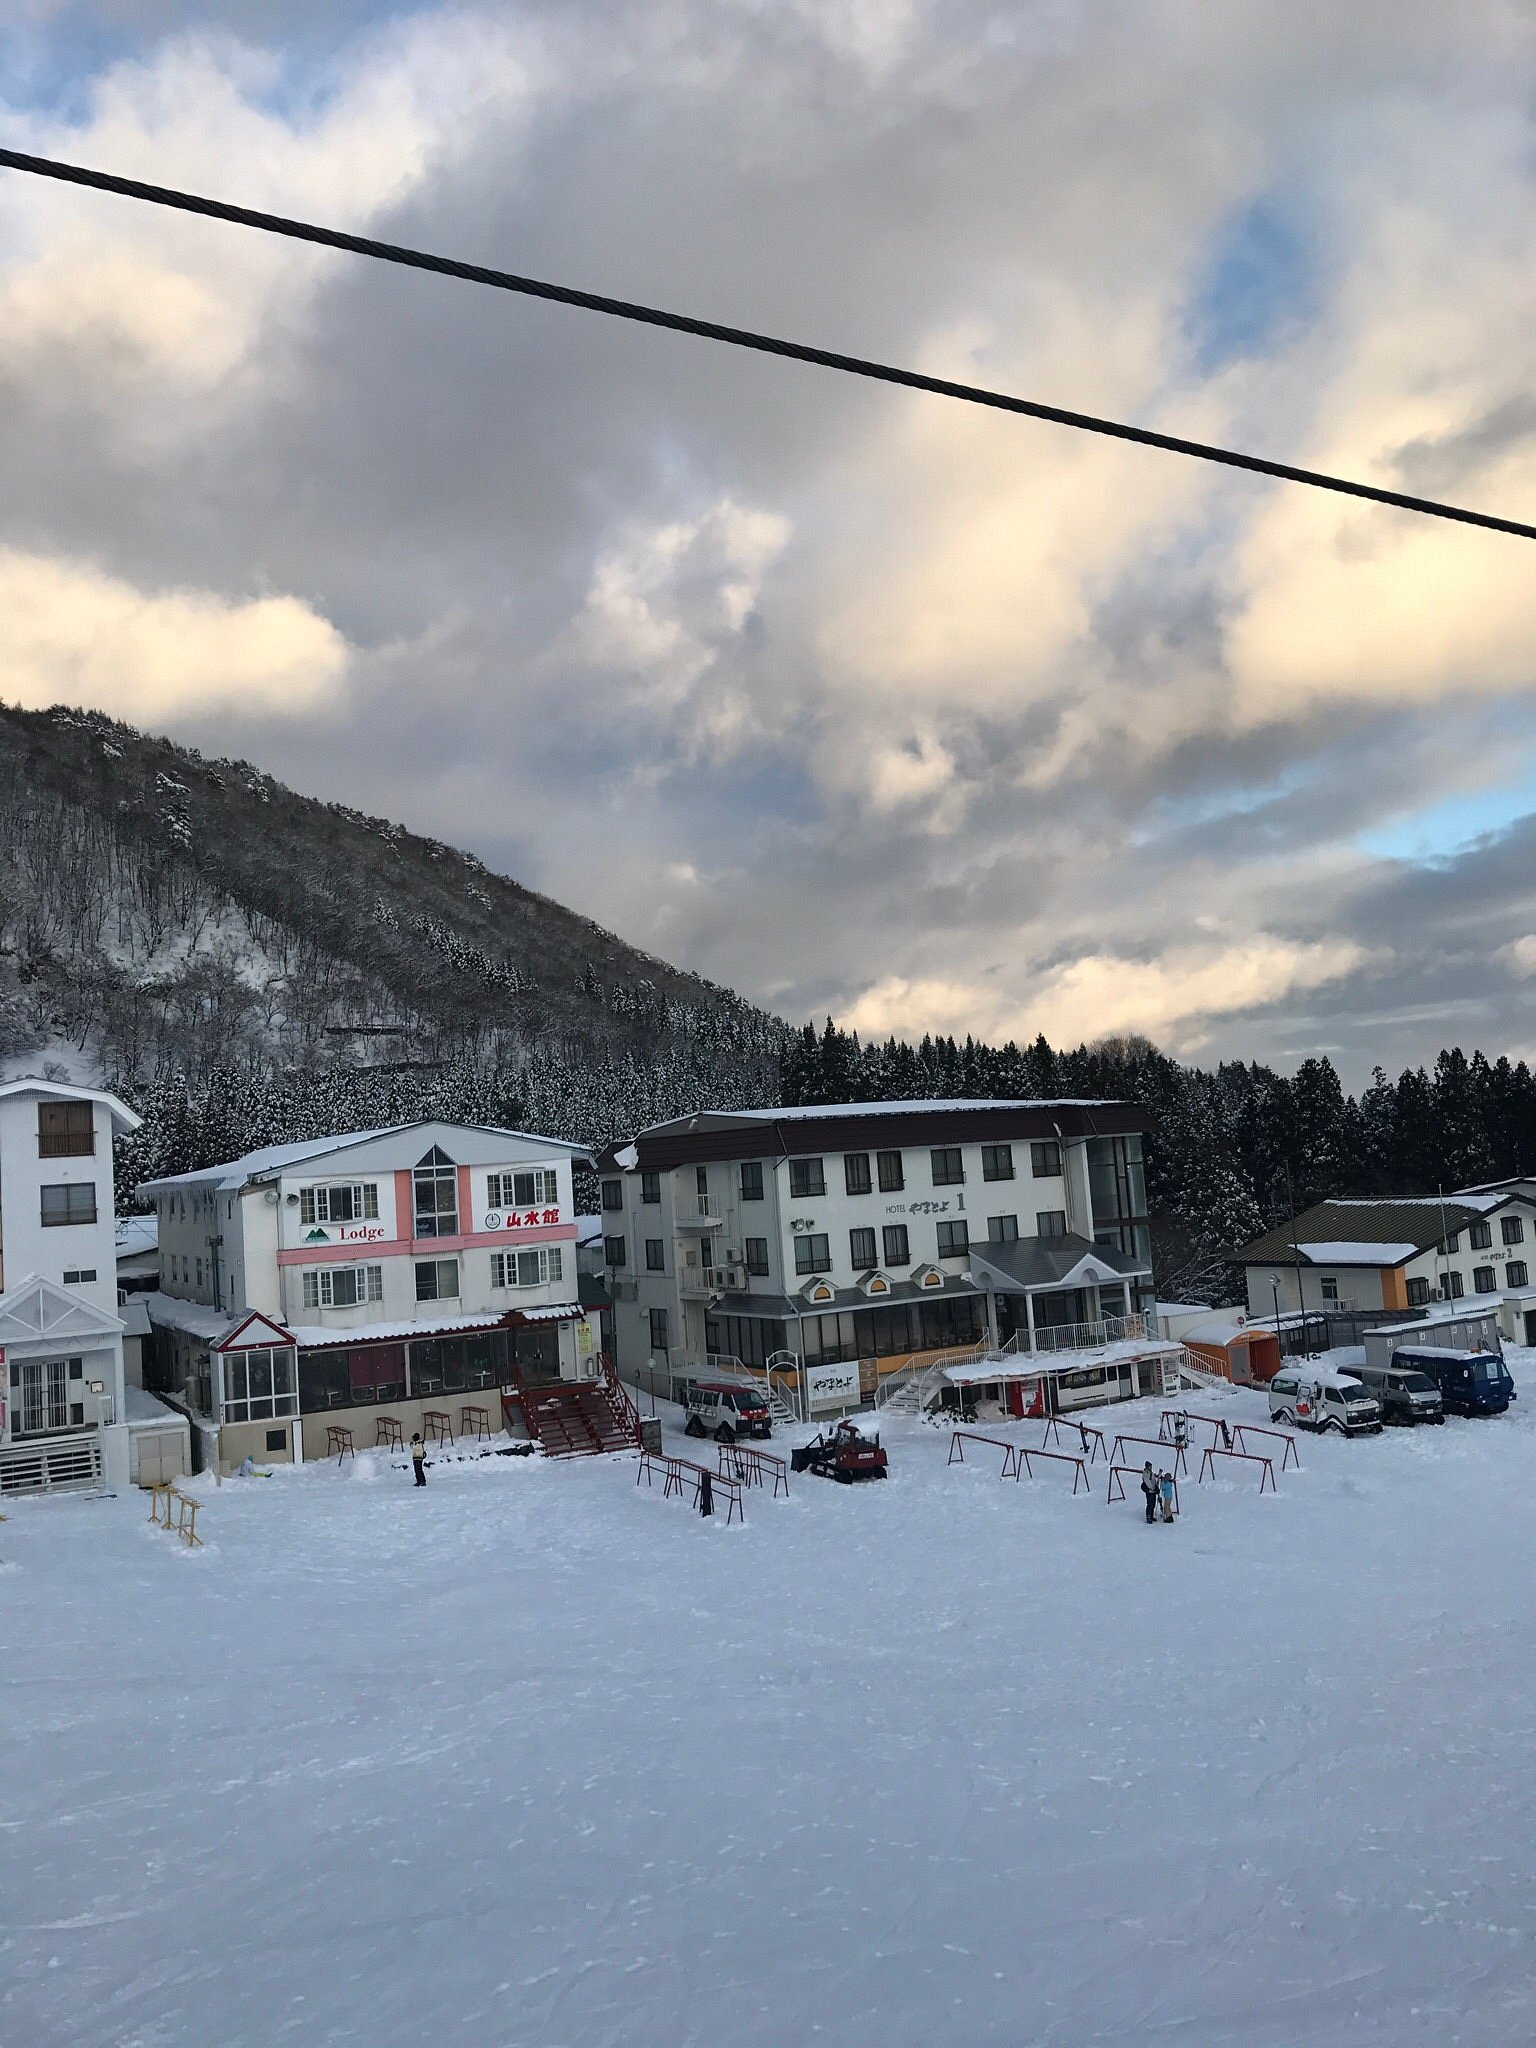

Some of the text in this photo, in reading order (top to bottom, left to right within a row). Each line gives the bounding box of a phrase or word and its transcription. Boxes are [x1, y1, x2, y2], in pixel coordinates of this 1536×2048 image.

[886, 1205, 906, 1214] HOTEL
[957, 1193, 966, 1211] 1
[506, 1208, 559, 1228] 山水館
[340, 1226, 385, 1241] Lodge
